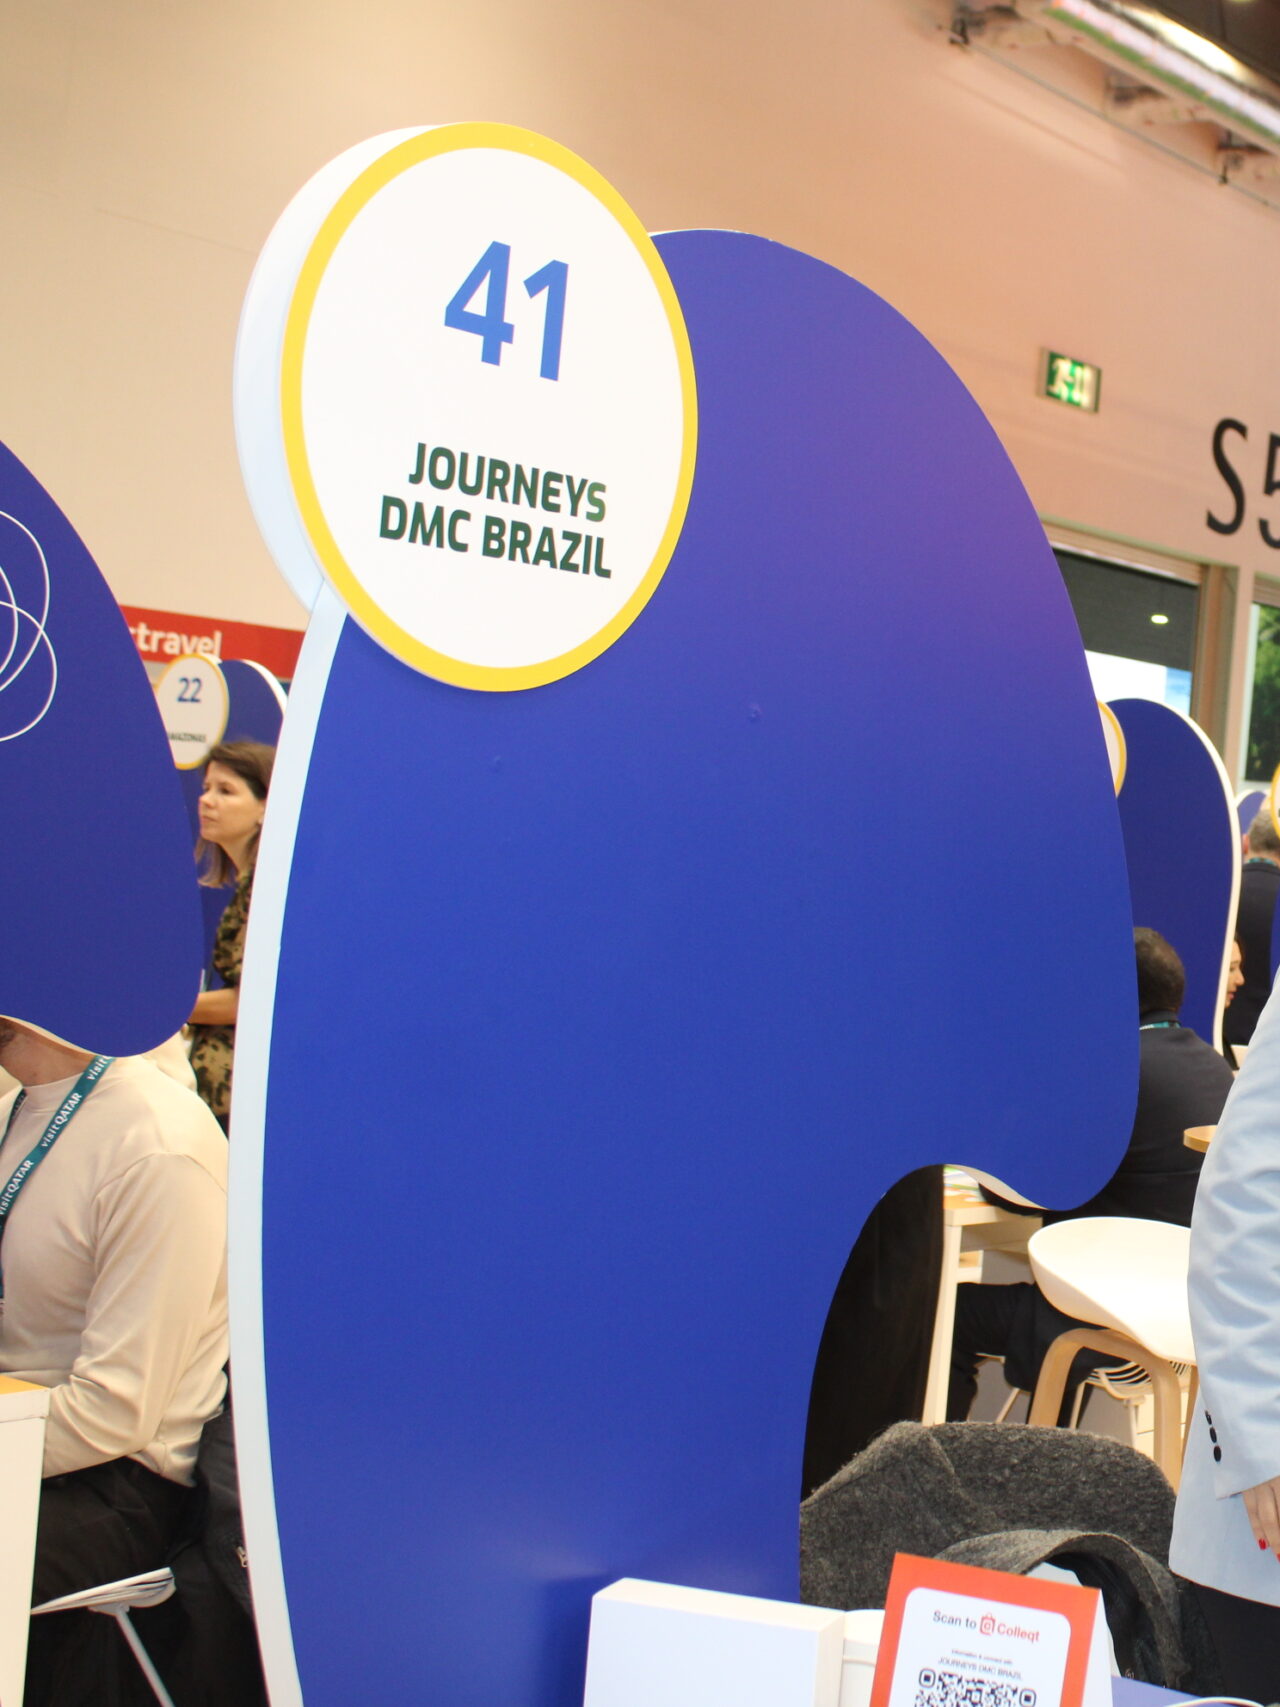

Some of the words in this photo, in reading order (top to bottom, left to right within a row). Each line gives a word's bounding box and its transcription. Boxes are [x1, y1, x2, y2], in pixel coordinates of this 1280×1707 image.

[444, 241, 569, 381] 41
[408, 442, 607, 522] JOURNEYS
[379, 495, 471, 552] DMC
[481, 516, 612, 579] BRAZIL
[177, 677, 202, 703] 22
[932, 1610, 962, 1627] Scan
[965, 1617, 977, 1629] to
[997, 1623, 1040, 1643] Colleqt
[938, 1656, 978, 1671] JOURNEYS
[979, 1664, 996, 1676] DMC
[997, 1668, 1022, 1681] BRAZIL
